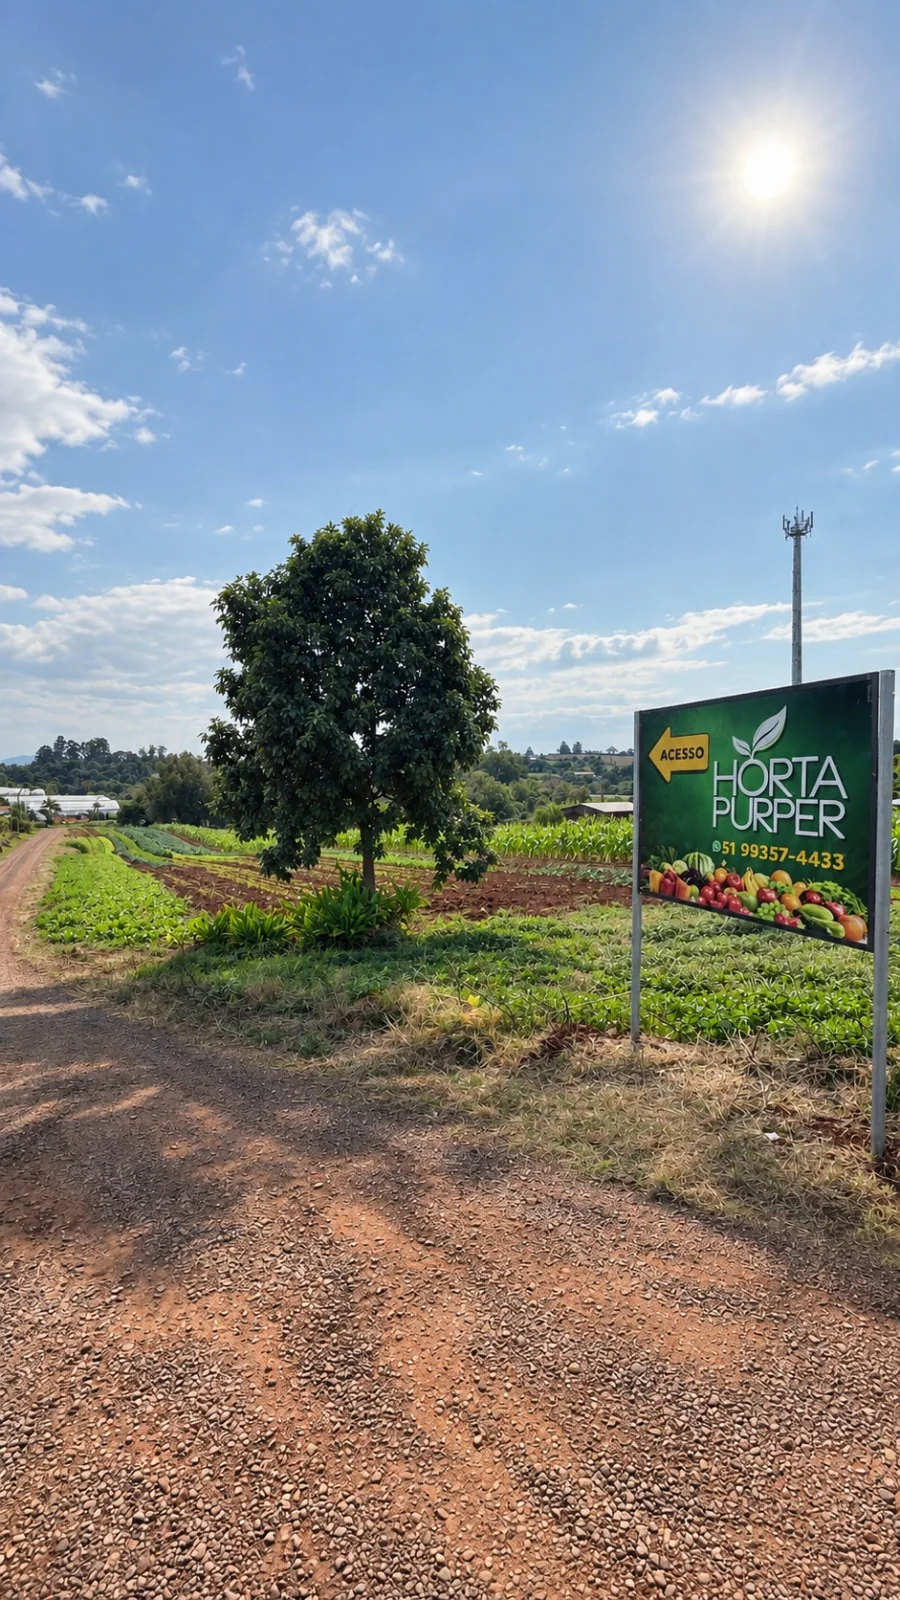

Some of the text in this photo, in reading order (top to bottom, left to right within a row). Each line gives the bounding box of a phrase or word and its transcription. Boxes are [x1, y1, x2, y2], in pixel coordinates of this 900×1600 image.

[660, 746, 705, 761] ACESSO
[713, 755, 848, 799] HORTA
[712, 796, 846, 839] PURPER
[722, 840, 845, 870] 51 99357-4433
